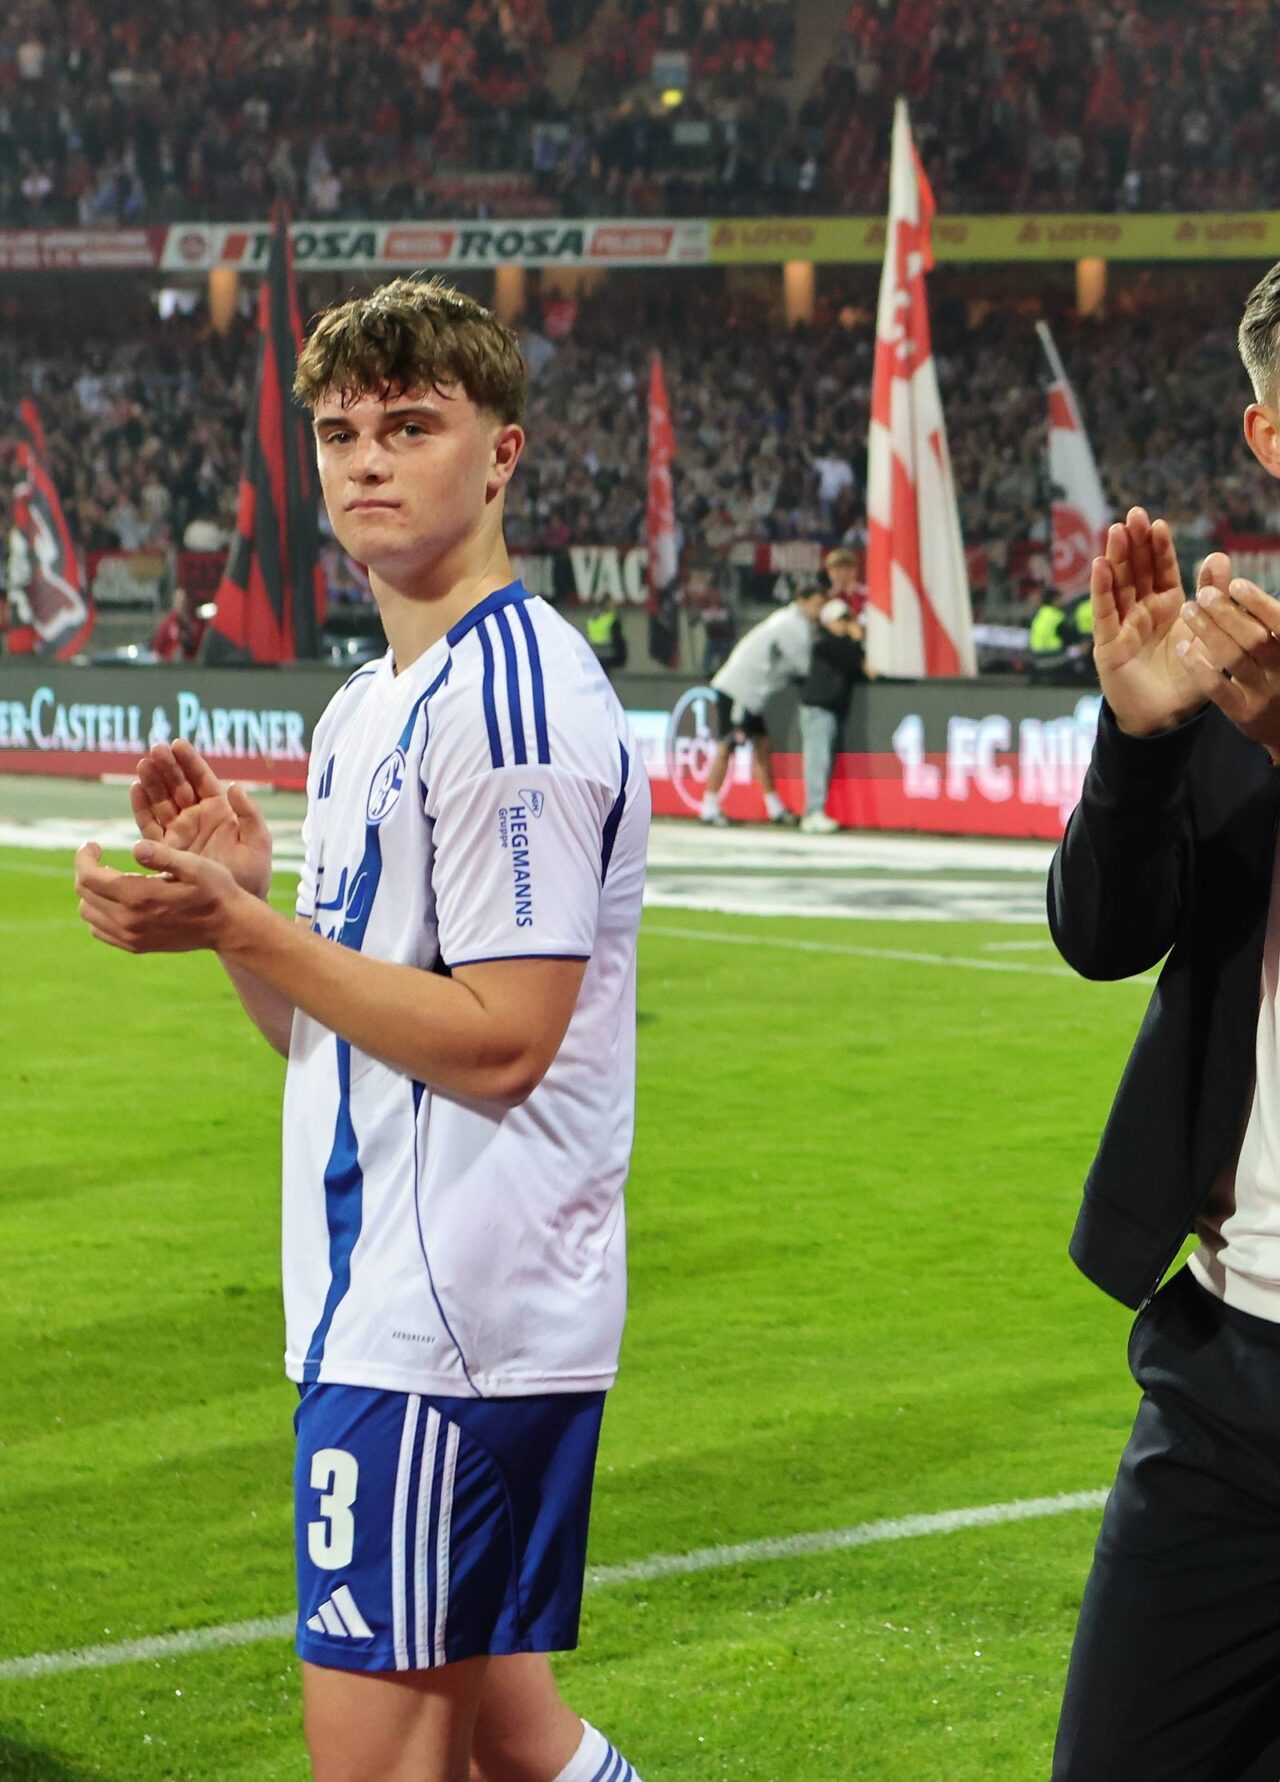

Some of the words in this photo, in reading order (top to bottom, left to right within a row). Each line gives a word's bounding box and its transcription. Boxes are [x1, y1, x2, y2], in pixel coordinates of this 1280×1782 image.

[459, 229, 584, 257] ROSA
[177, 691, 306, 761] PARTNER
[946, 715, 1013, 802] FC
[498, 807, 508, 848] Gruppe
[509, 806, 533, 928] HEGMANNS
[308, 1448, 359, 1571] 3
